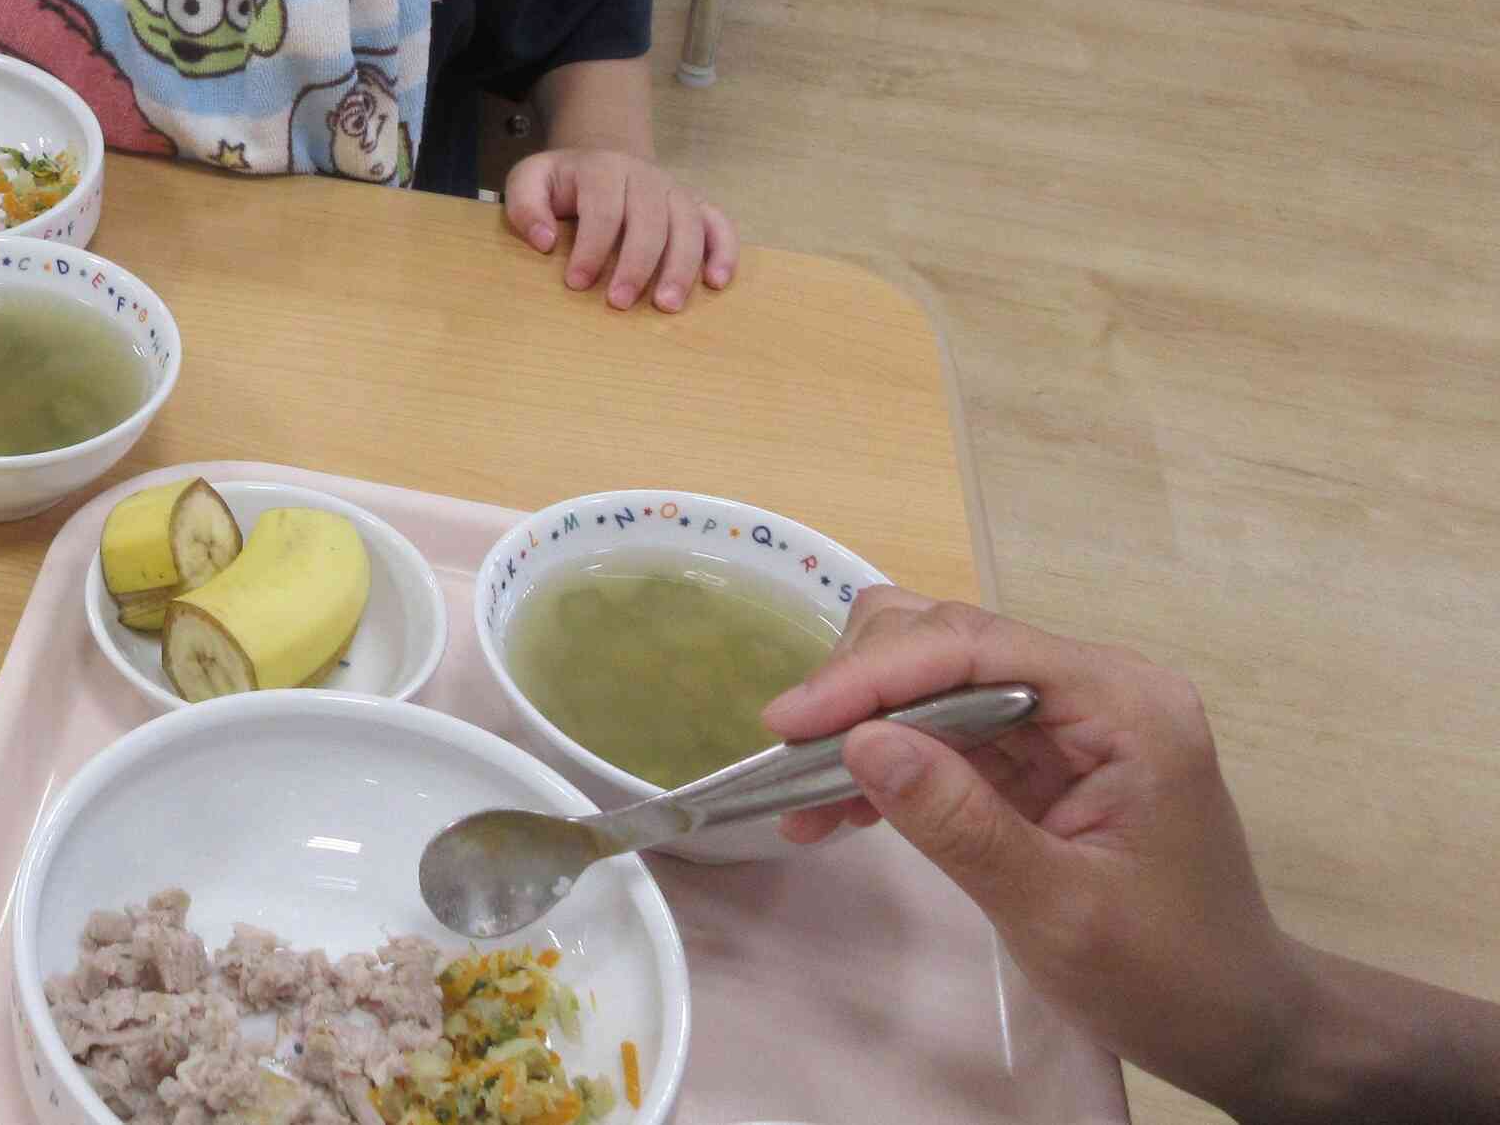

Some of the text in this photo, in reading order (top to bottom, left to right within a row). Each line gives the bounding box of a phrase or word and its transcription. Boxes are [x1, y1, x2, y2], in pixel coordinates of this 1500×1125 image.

[18, 257, 31, 271] C
[56, 259, 70, 275] D
[91, 271, 106, 289] E
[116, 296, 126, 312] F
[563, 512, 580, 534] M
[614, 507, 636, 529] N
[660, 502, 678, 519] O
[702, 518, 717, 534] P
[752, 525, 773, 548] Q
[800, 554, 818, 574] R
[838, 583, 853, 603] S
